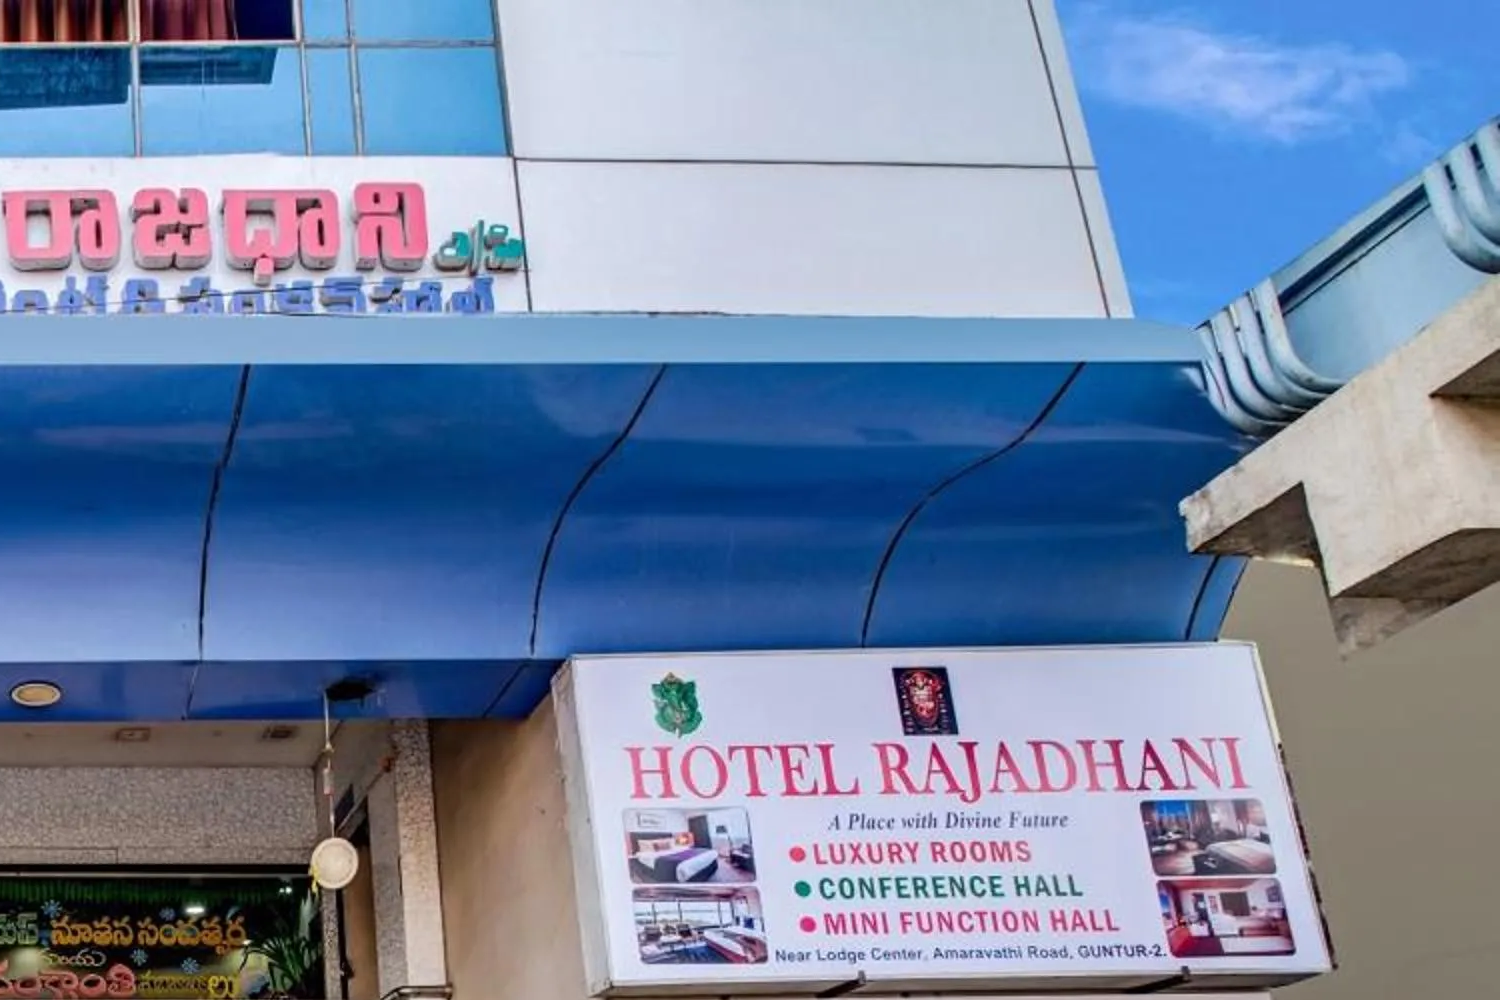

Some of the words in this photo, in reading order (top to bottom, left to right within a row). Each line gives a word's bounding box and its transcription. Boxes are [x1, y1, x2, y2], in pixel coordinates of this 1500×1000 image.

[2, 182, 428, 286] రాజధాని
[624, 743, 861, 799] HOTEL
[878, 737, 1248, 802] RAJADHANI
[828, 812, 842, 829] A
[848, 812, 896, 831] Place
[901, 812, 938, 830] with
[944, 811, 1002, 830] Divine
[1009, 811, 1069, 829] Future
[813, 840, 922, 866] LUXURY
[931, 839, 1031, 864] ROOMS
[819, 874, 1006, 901] CONFERENCE
[1014, 872, 1084, 898] HALL
[824, 909, 890, 936] MINI
[899, 909, 1043, 934] FUNCTION
[1051, 908, 1121, 933] HALL
[775, 947, 812, 963] Near
[816, 947, 867, 965] Lodge
[933, 946, 1024, 961] Amaravathi
[1027, 945, 1075, 960] Road,
[1078, 943, 1168, 960] GUNTUR-2.
